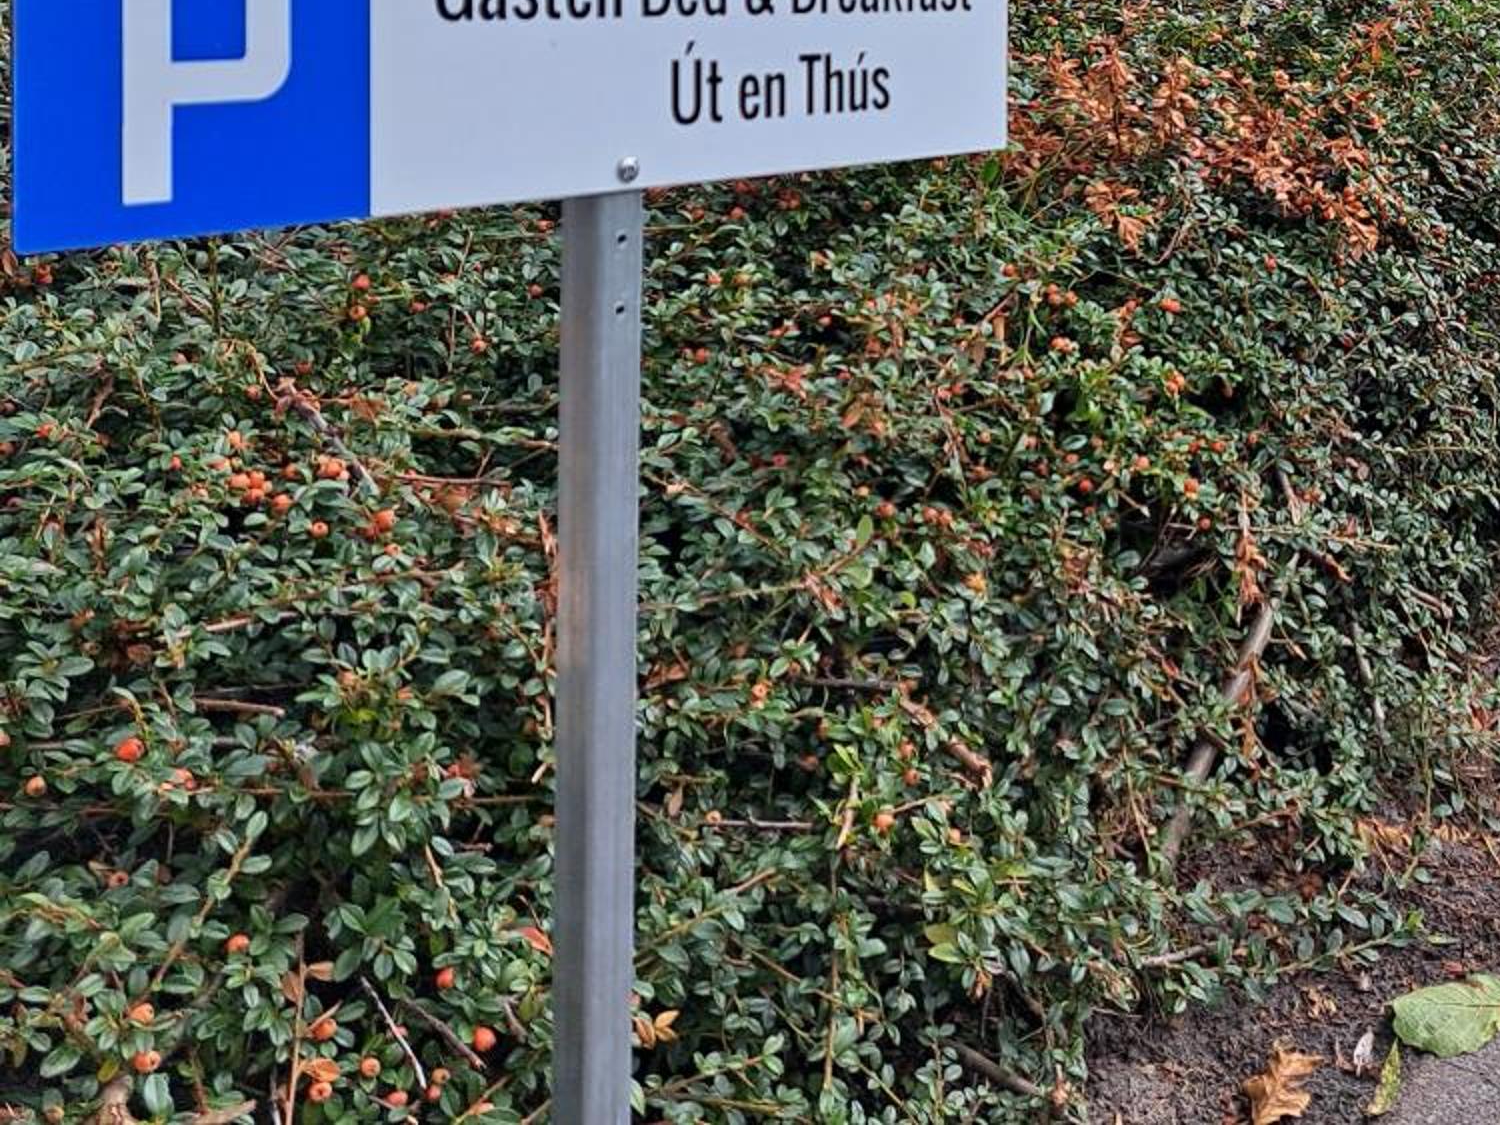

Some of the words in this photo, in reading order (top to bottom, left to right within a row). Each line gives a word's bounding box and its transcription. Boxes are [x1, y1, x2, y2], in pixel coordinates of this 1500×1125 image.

[670, 41, 724, 125] Út
[738, 73, 787, 120] en
[798, 49, 891, 116] Thús
